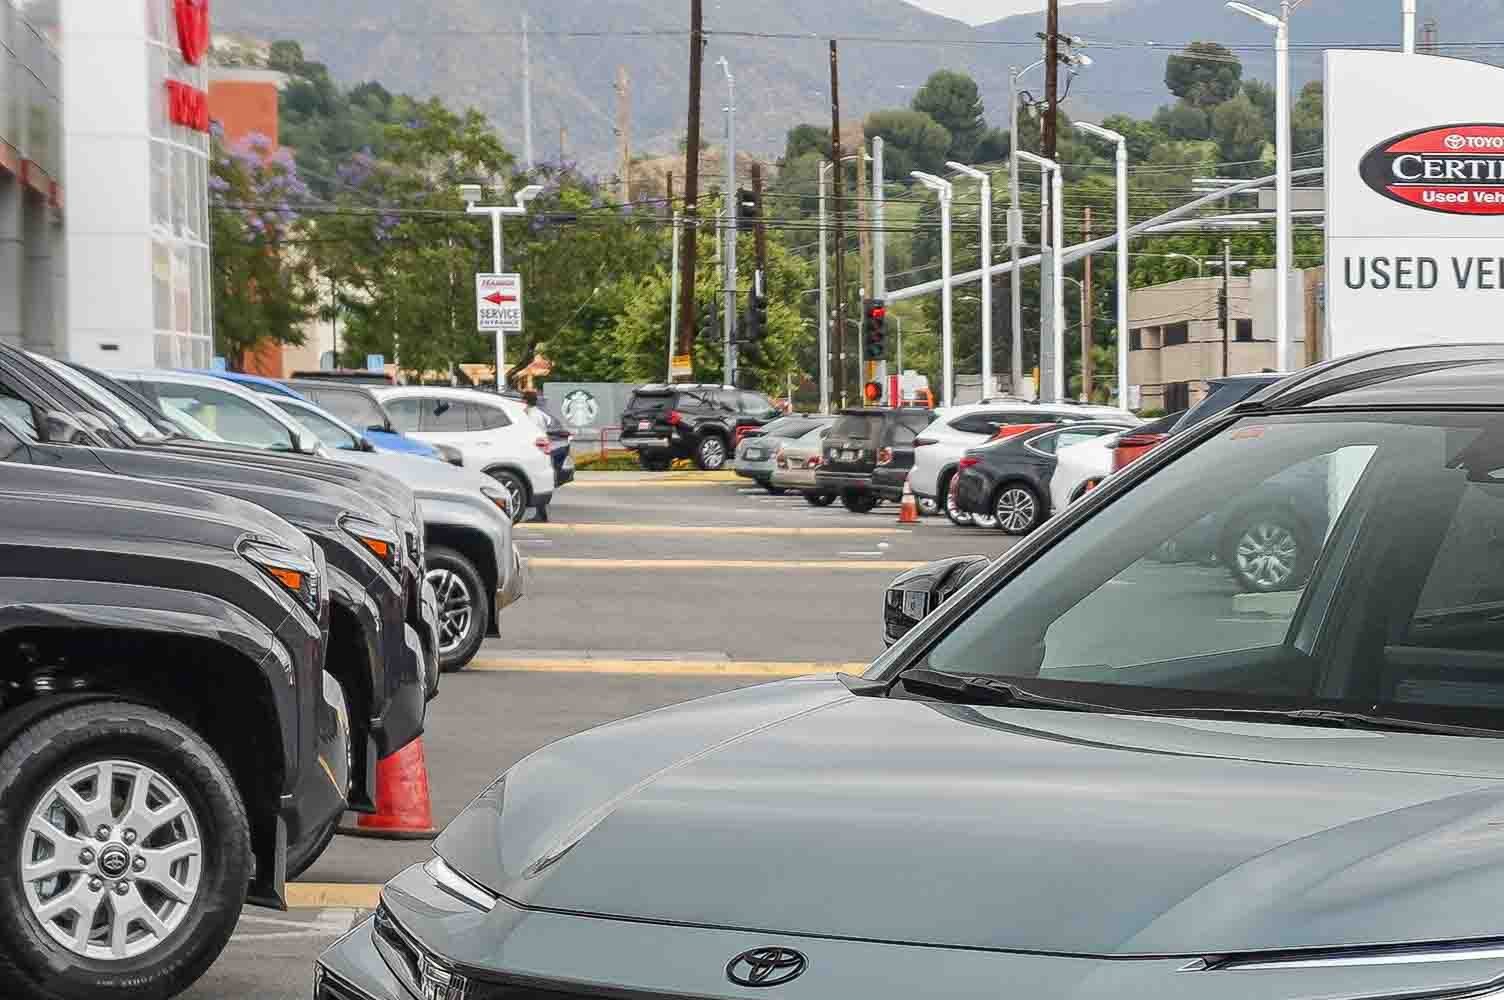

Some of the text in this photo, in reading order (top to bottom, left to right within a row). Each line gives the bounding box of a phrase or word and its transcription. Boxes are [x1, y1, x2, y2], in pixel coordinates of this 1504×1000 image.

[1422, 190, 1468, 203] Used
[1344, 256, 1438, 290] USED
[479, 308, 521, 320] SERVICE
